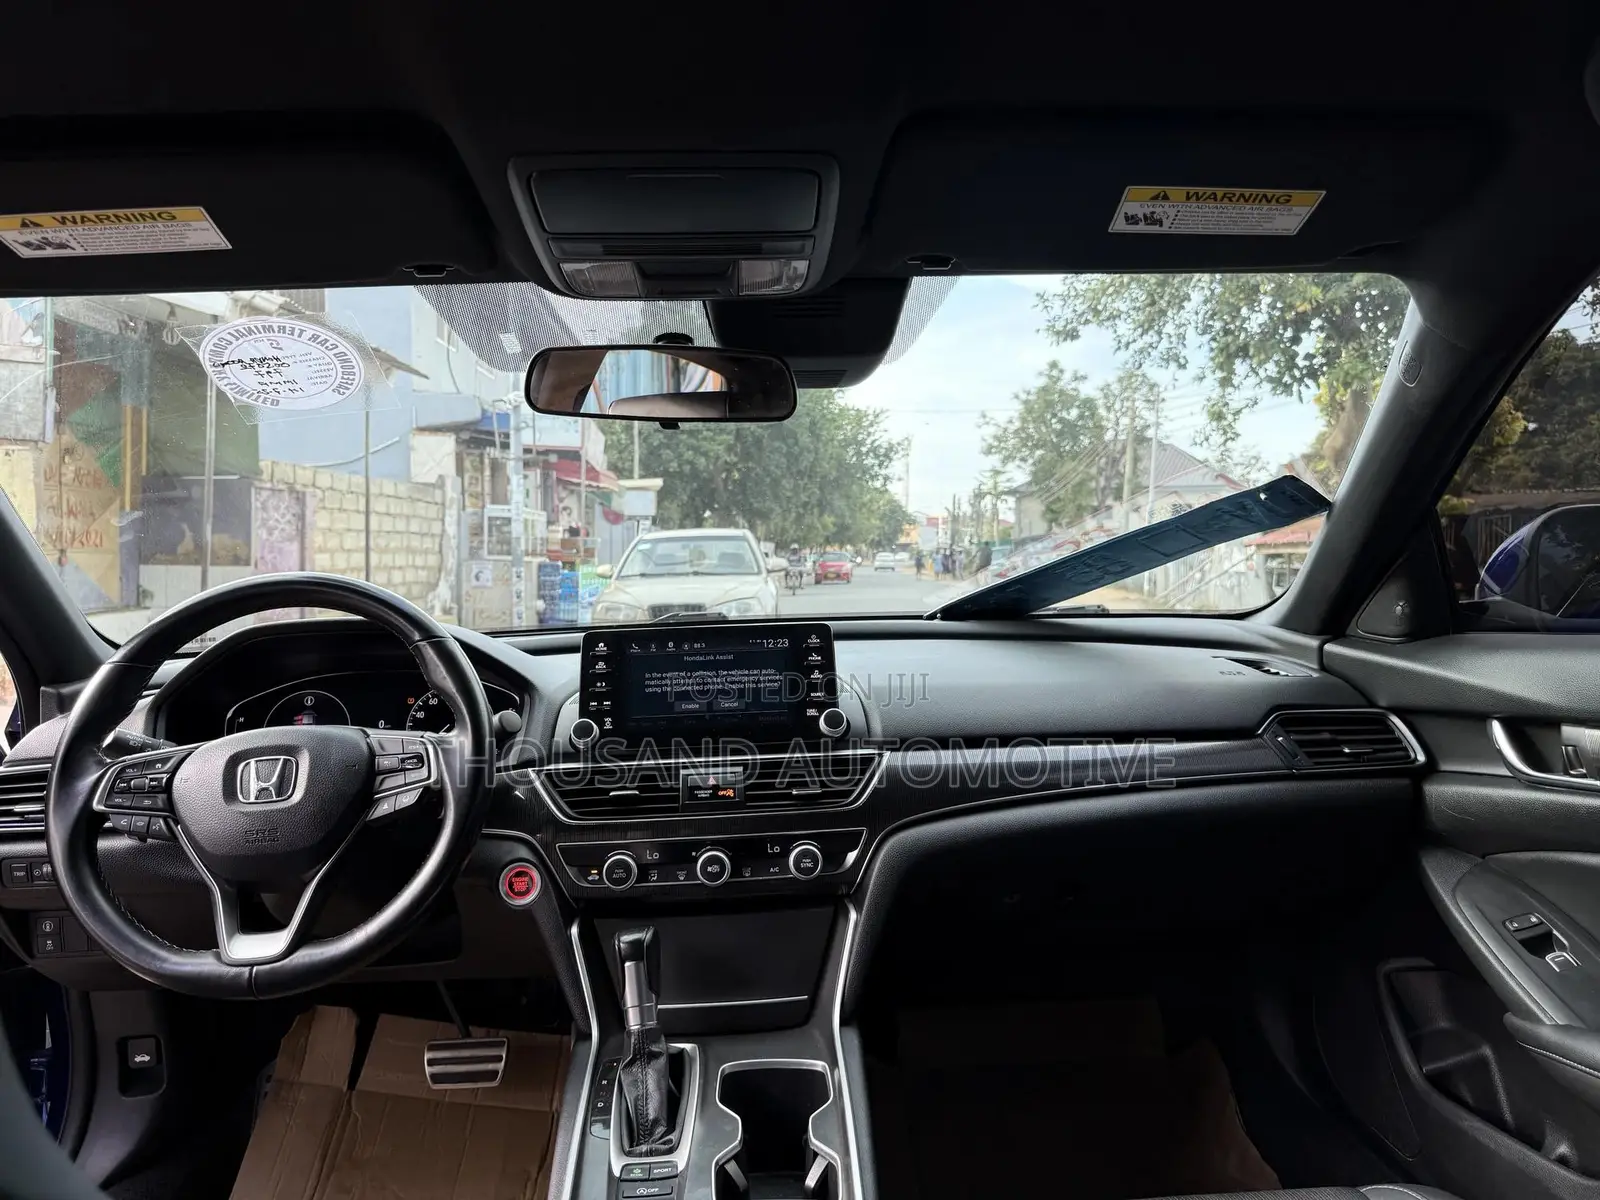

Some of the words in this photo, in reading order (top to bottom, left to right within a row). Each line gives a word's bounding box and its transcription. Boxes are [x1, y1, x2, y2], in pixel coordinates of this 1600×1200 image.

[1184, 191, 1293, 204] WARNING
[52, 211, 177, 226] WARNING
[80, 225, 140, 233] ADVANCED
[763, 639, 789, 648] 12:23
[378, 720, 385, 729] 0
[767, 843, 781, 853] Lo
[646, 849, 660, 860] Lo
